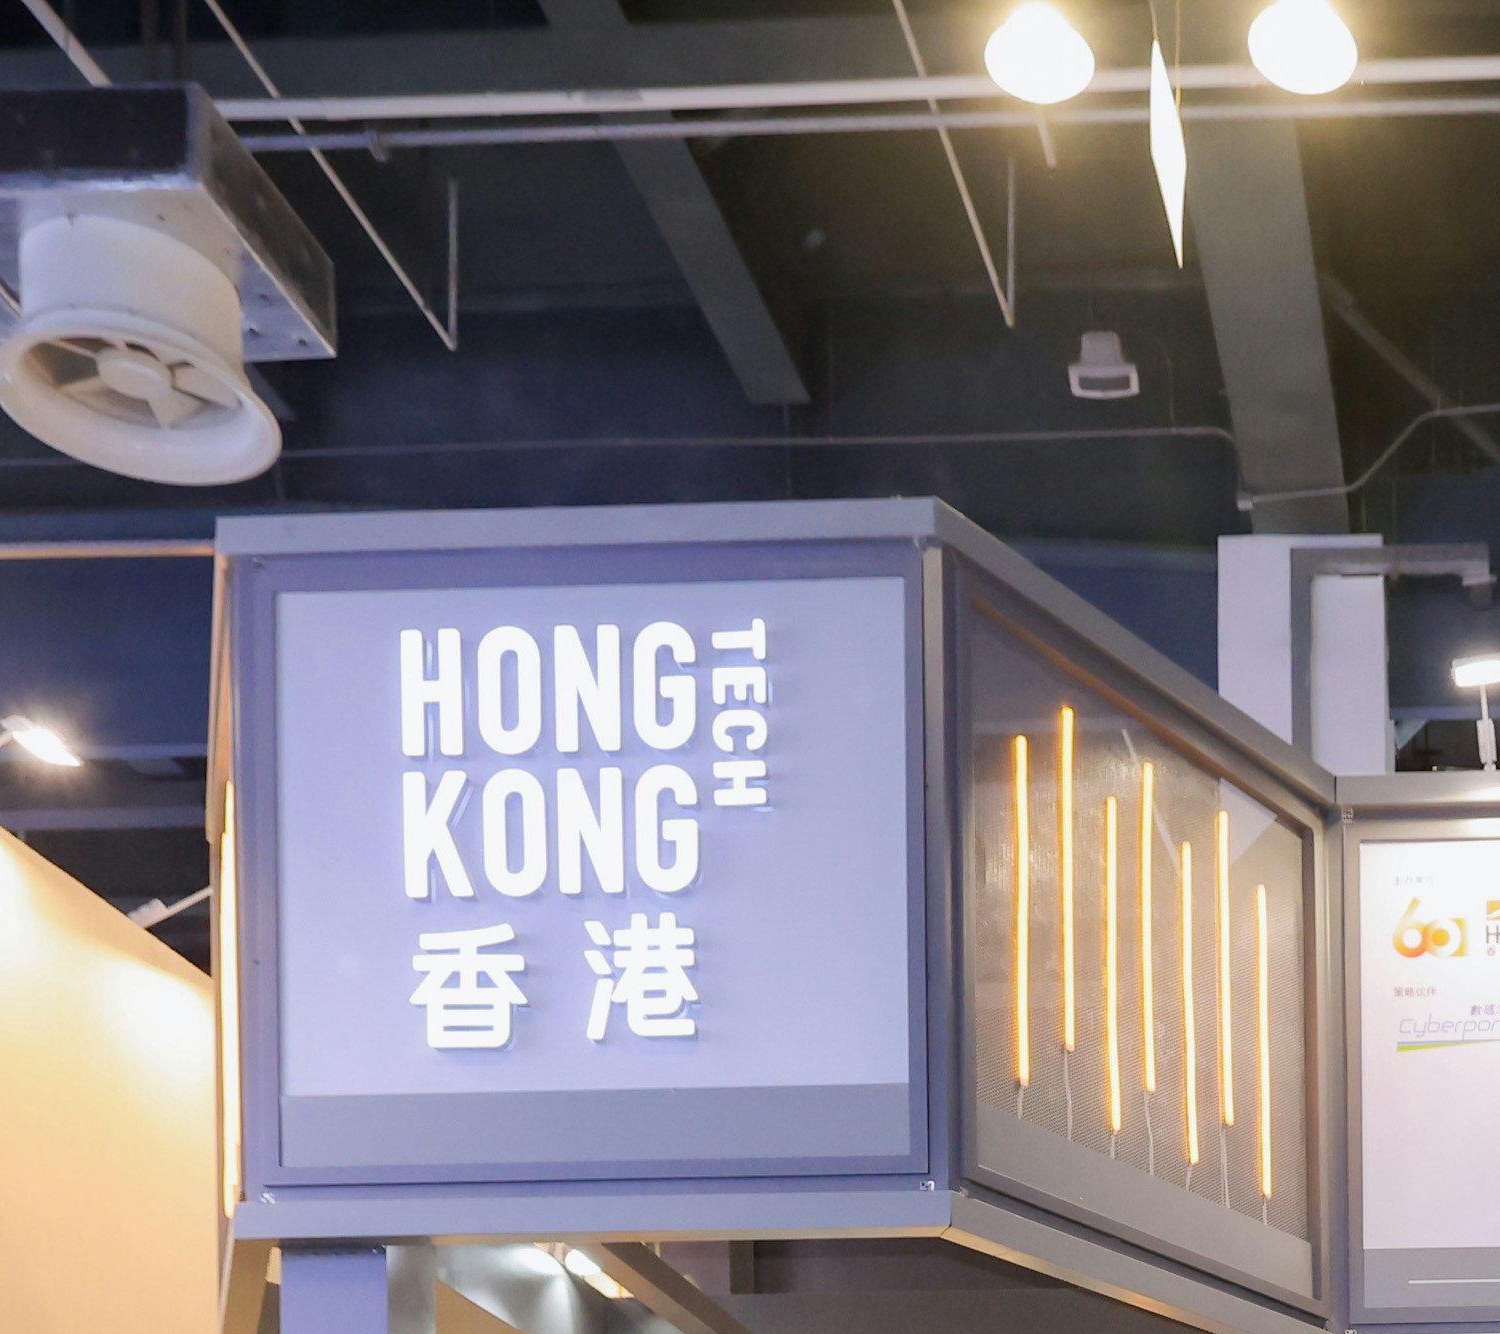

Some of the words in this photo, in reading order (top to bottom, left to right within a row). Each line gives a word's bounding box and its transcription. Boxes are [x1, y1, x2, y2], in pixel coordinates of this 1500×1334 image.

[400, 621, 698, 756] HONG
[711, 618, 768, 807] TECH
[402, 764, 700, 899] KONG
[408, 912, 699, 1049] 香港
